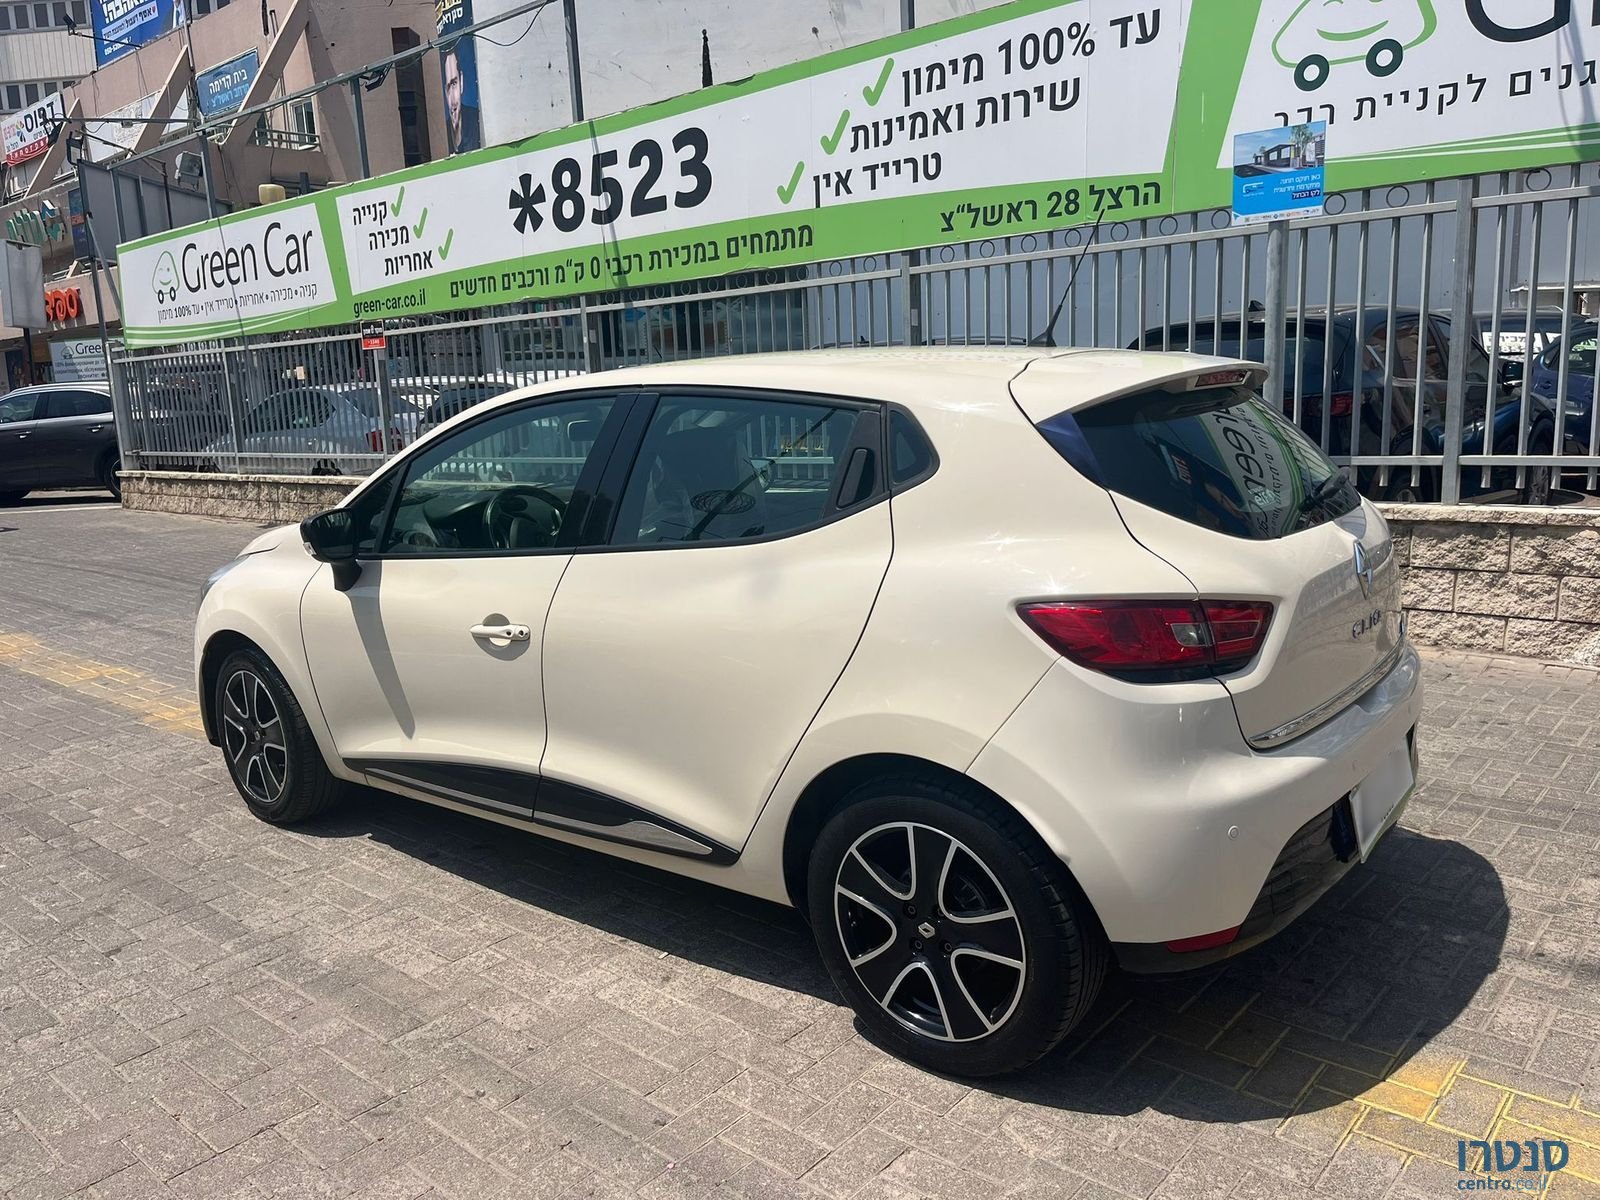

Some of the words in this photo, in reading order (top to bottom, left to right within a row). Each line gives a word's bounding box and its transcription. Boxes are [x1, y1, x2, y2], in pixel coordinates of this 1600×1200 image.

[1109, 8, 1161, 49] עד
[998, 22, 1096, 75] 100%
[209, 74, 232, 95] קדימה
[233, 69, 248, 84] בית
[902, 53, 984, 107] מימון
[975, 77, 1081, 128] שירות
[1353, 73, 1487, 122] לקניית
[850, 103, 964, 154] ואמינות
[863, 152, 942, 191] טרייד
[812, 168, 853, 209] אין
[1089, 182, 1162, 212] הרצל
[353, 201, 387, 226] קנייה
[1047, 188, 1080, 219] 28
[369, 225, 410, 251] מכירה
[727, 224, 813, 258] מתמחים
[182, 243, 259, 293] Green
[263, 222, 313, 277] Car
[384, 250, 433, 276] אחריות
[605, 253, 643, 277] רכבי
[648, 236, 720, 271] במכירת
[501, 266, 549, 290] ורכבים
[590, 256, 600, 279] 0
[270, 287, 293, 302] מכירה
[299, 283, 318, 300] קניה
[450, 275, 497, 298] חדשים
[174, 304, 192, 318] 100%
[191, 303, 200, 316] עד
[204, 300, 214, 316] אין
[214, 297, 233, 310] טרייד
[239, 291, 265, 308] אחריות
[353, 288, 426, 318] green-car.co.il
[158, 308, 174, 324] מימון
[75, 343, 102, 355] Gree
